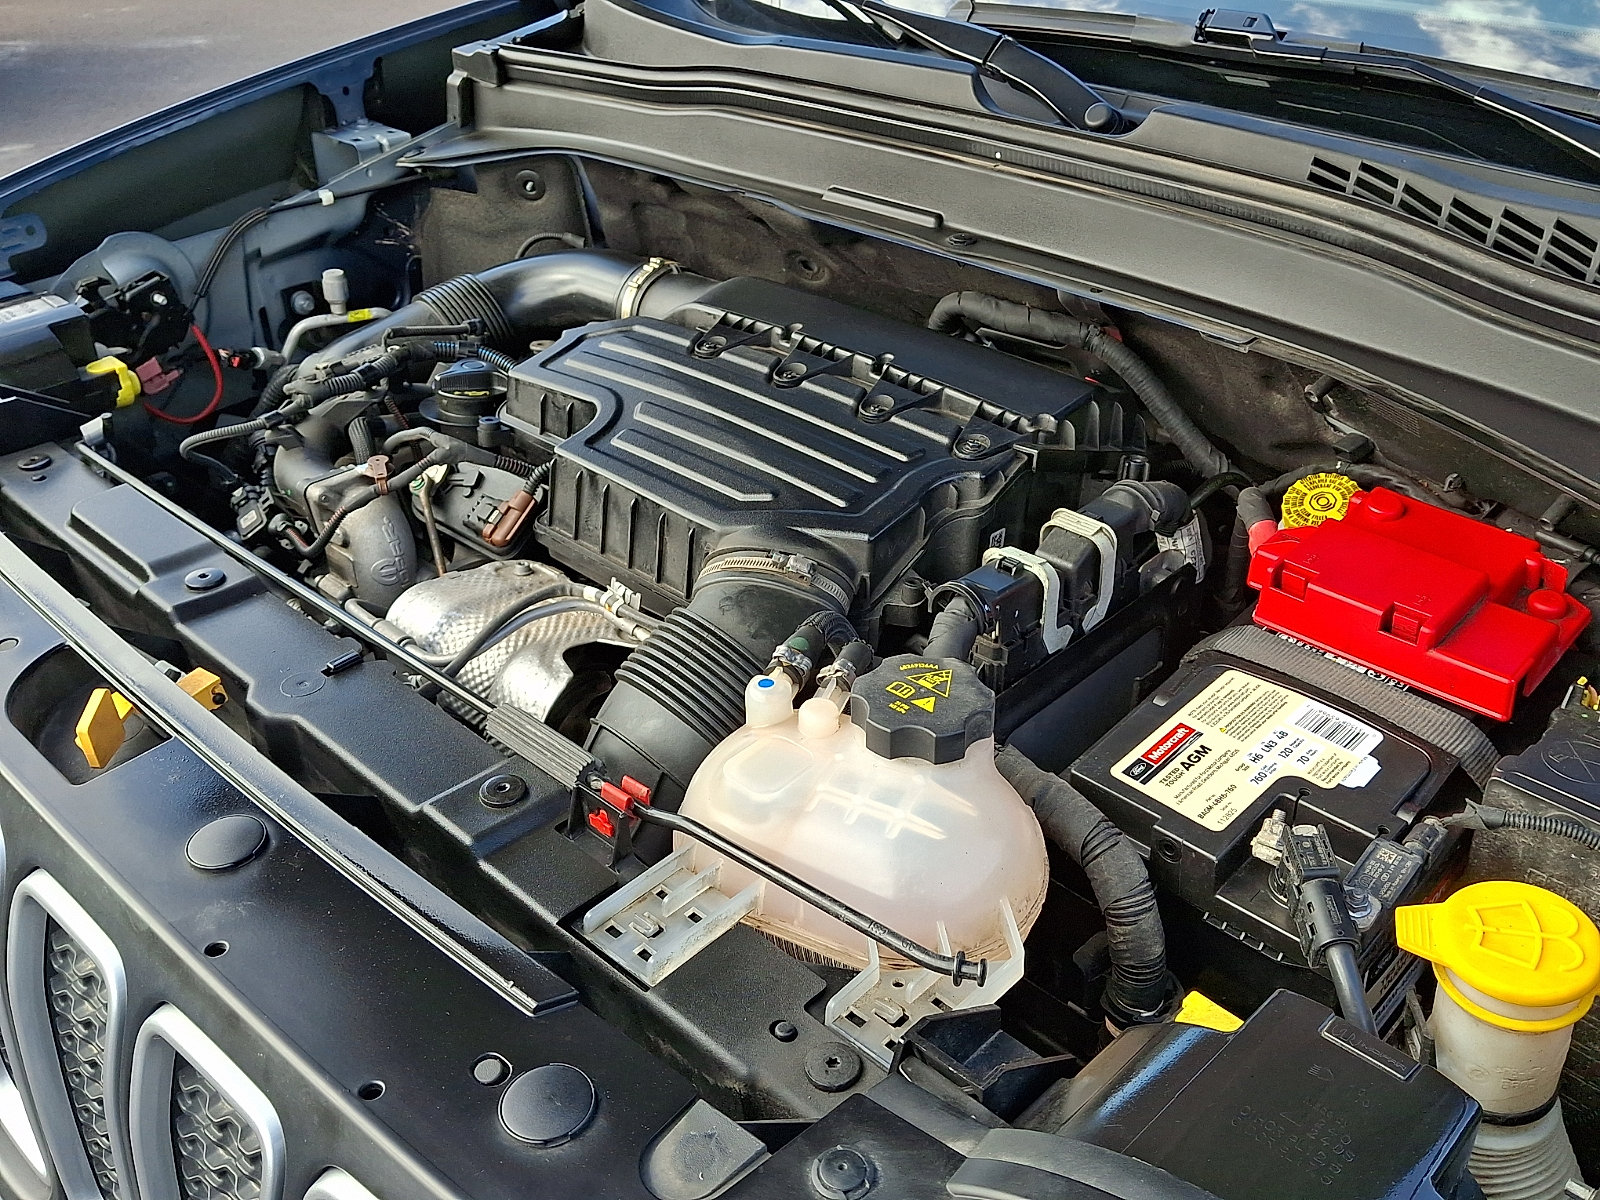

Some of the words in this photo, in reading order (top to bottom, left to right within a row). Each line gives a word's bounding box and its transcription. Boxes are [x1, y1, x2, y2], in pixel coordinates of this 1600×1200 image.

[1147, 727, 1190, 761] Motorcraft
[1249, 753, 1264, 764] H6
[1261, 740, 1278, 753] LN3
[1276, 731, 1289, 740] 48
[1179, 744, 1212, 772] AGM
[1278, 747, 1294, 759] 120
[1297, 755, 1310, 765] 70
[1159, 767, 1180, 784] TESTED
[1250, 771, 1267, 785] 760
